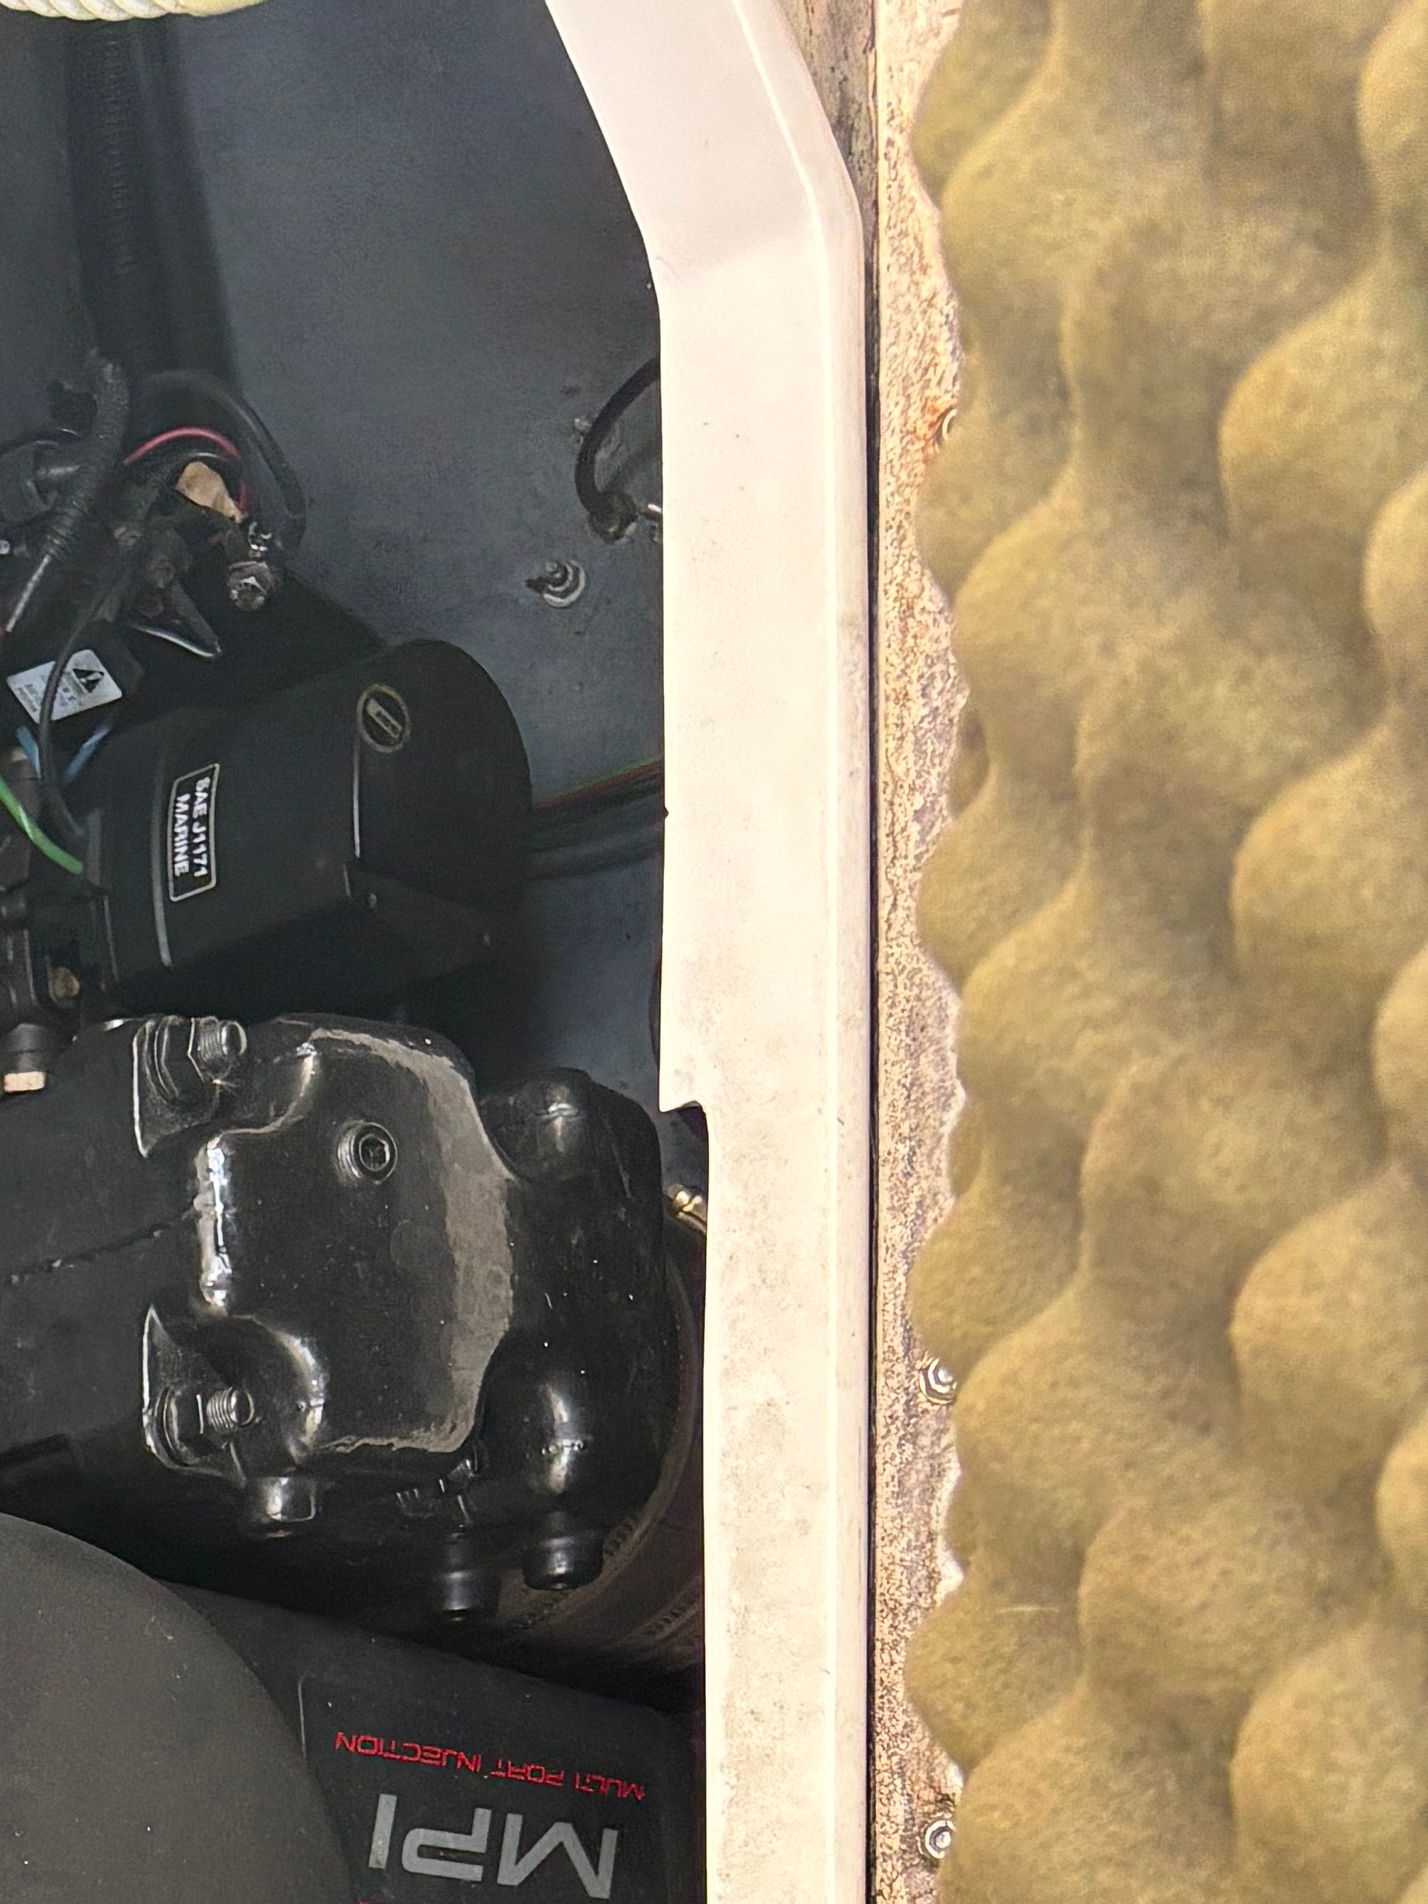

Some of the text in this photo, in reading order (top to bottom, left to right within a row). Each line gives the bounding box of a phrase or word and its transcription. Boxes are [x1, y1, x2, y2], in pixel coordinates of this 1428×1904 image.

[173, 792, 191, 877] MARINE
[191, 775, 210, 878] SAE J1171
[335, 1731, 647, 1801] MULTI PORT INJECTION
[369, 1795, 617, 1899] MPI
